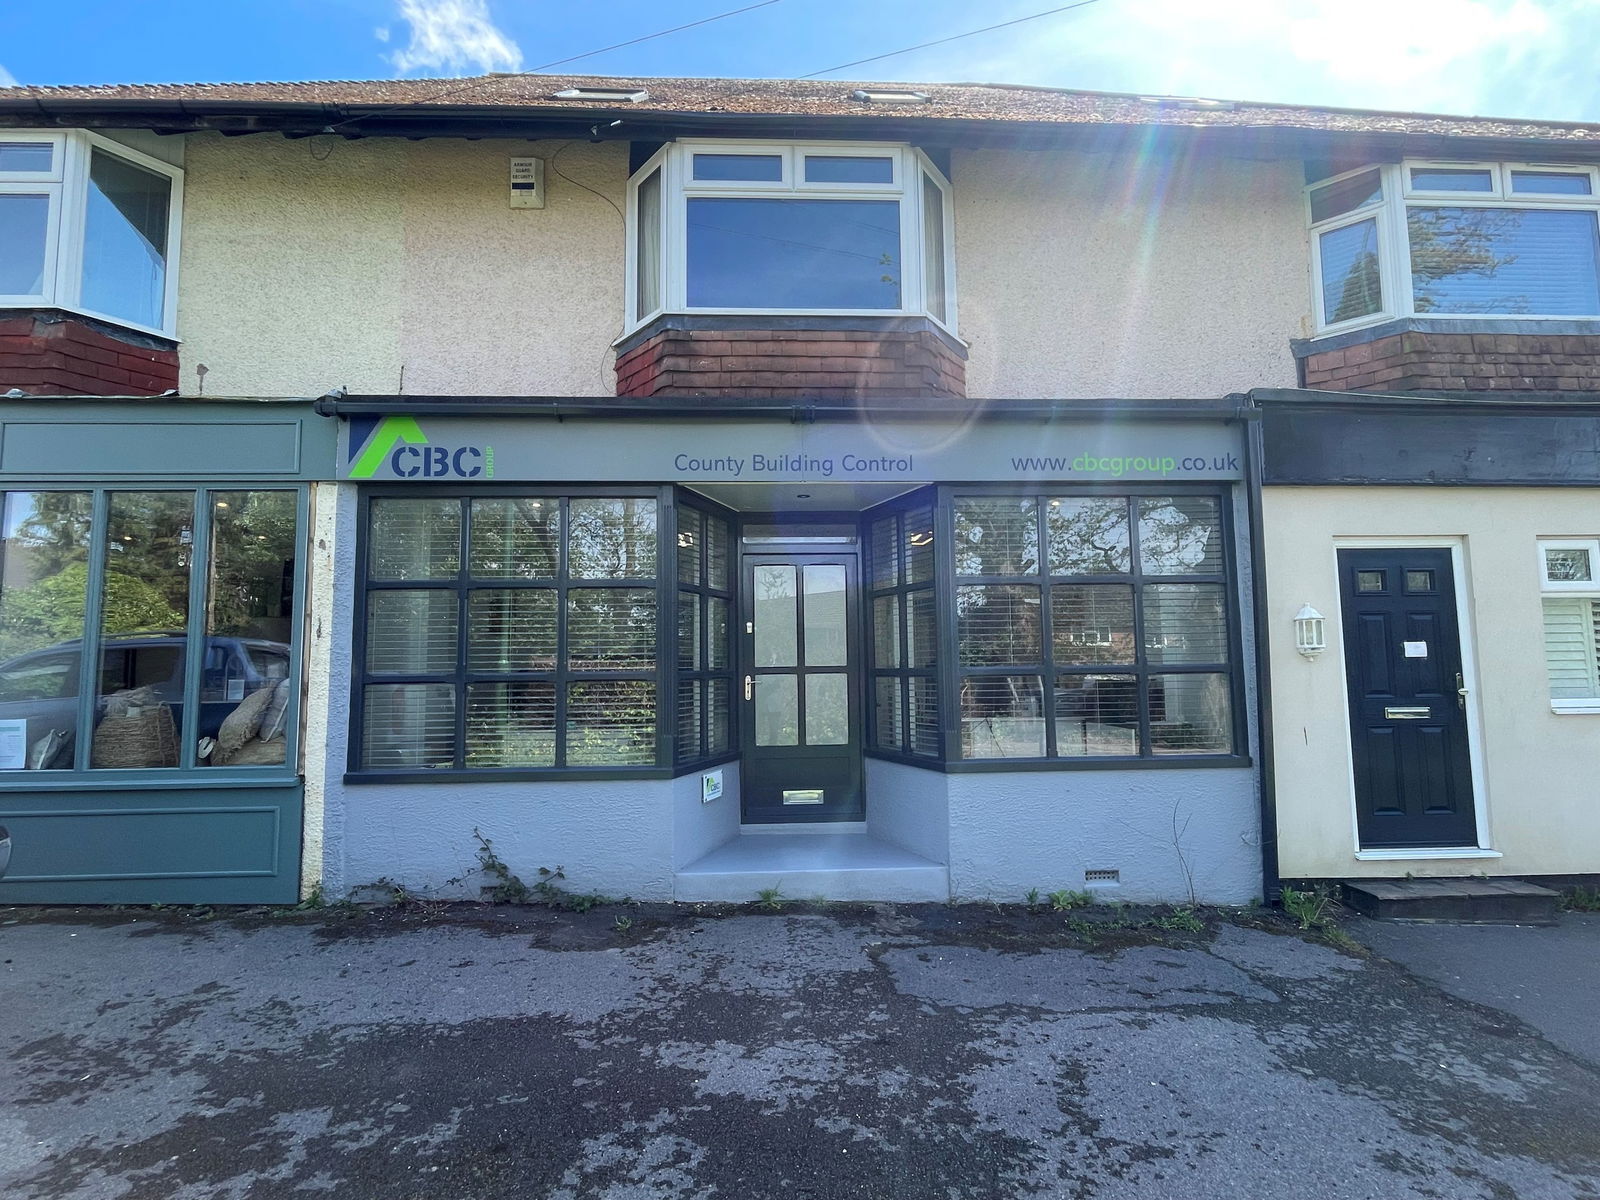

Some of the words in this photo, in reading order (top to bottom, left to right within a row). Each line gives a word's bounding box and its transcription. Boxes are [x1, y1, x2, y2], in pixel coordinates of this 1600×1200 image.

[391, 446, 482, 478] CBC
[484, 445, 494, 478] GROUP
[674, 454, 745, 476] County
[752, 454, 834, 477] Building
[842, 454, 914, 472] Control
[1011, 452, 1239, 477] www.cbcgroup.co.uk
